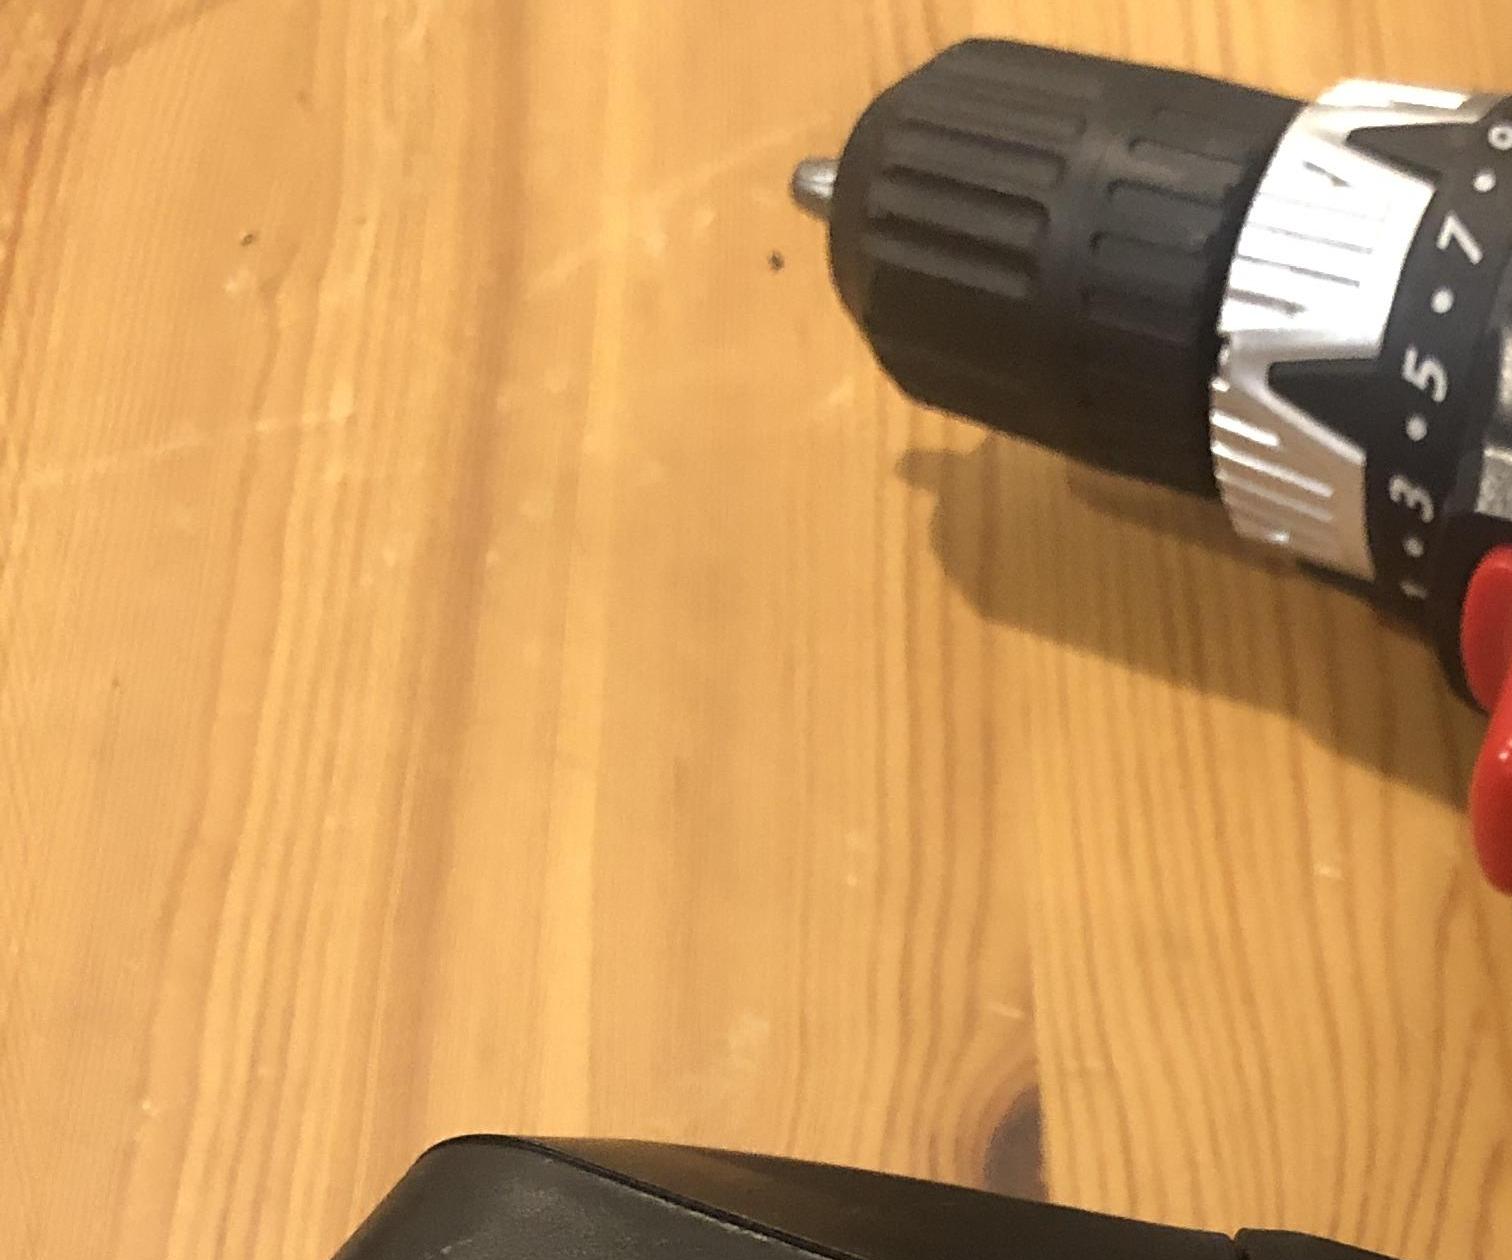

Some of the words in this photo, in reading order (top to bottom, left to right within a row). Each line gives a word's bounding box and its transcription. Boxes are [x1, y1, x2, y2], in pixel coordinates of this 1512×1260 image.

[1436, 210, 1484, 265] 7
[1401, 345, 1449, 404] 5
[1389, 475, 1434, 523] 3
